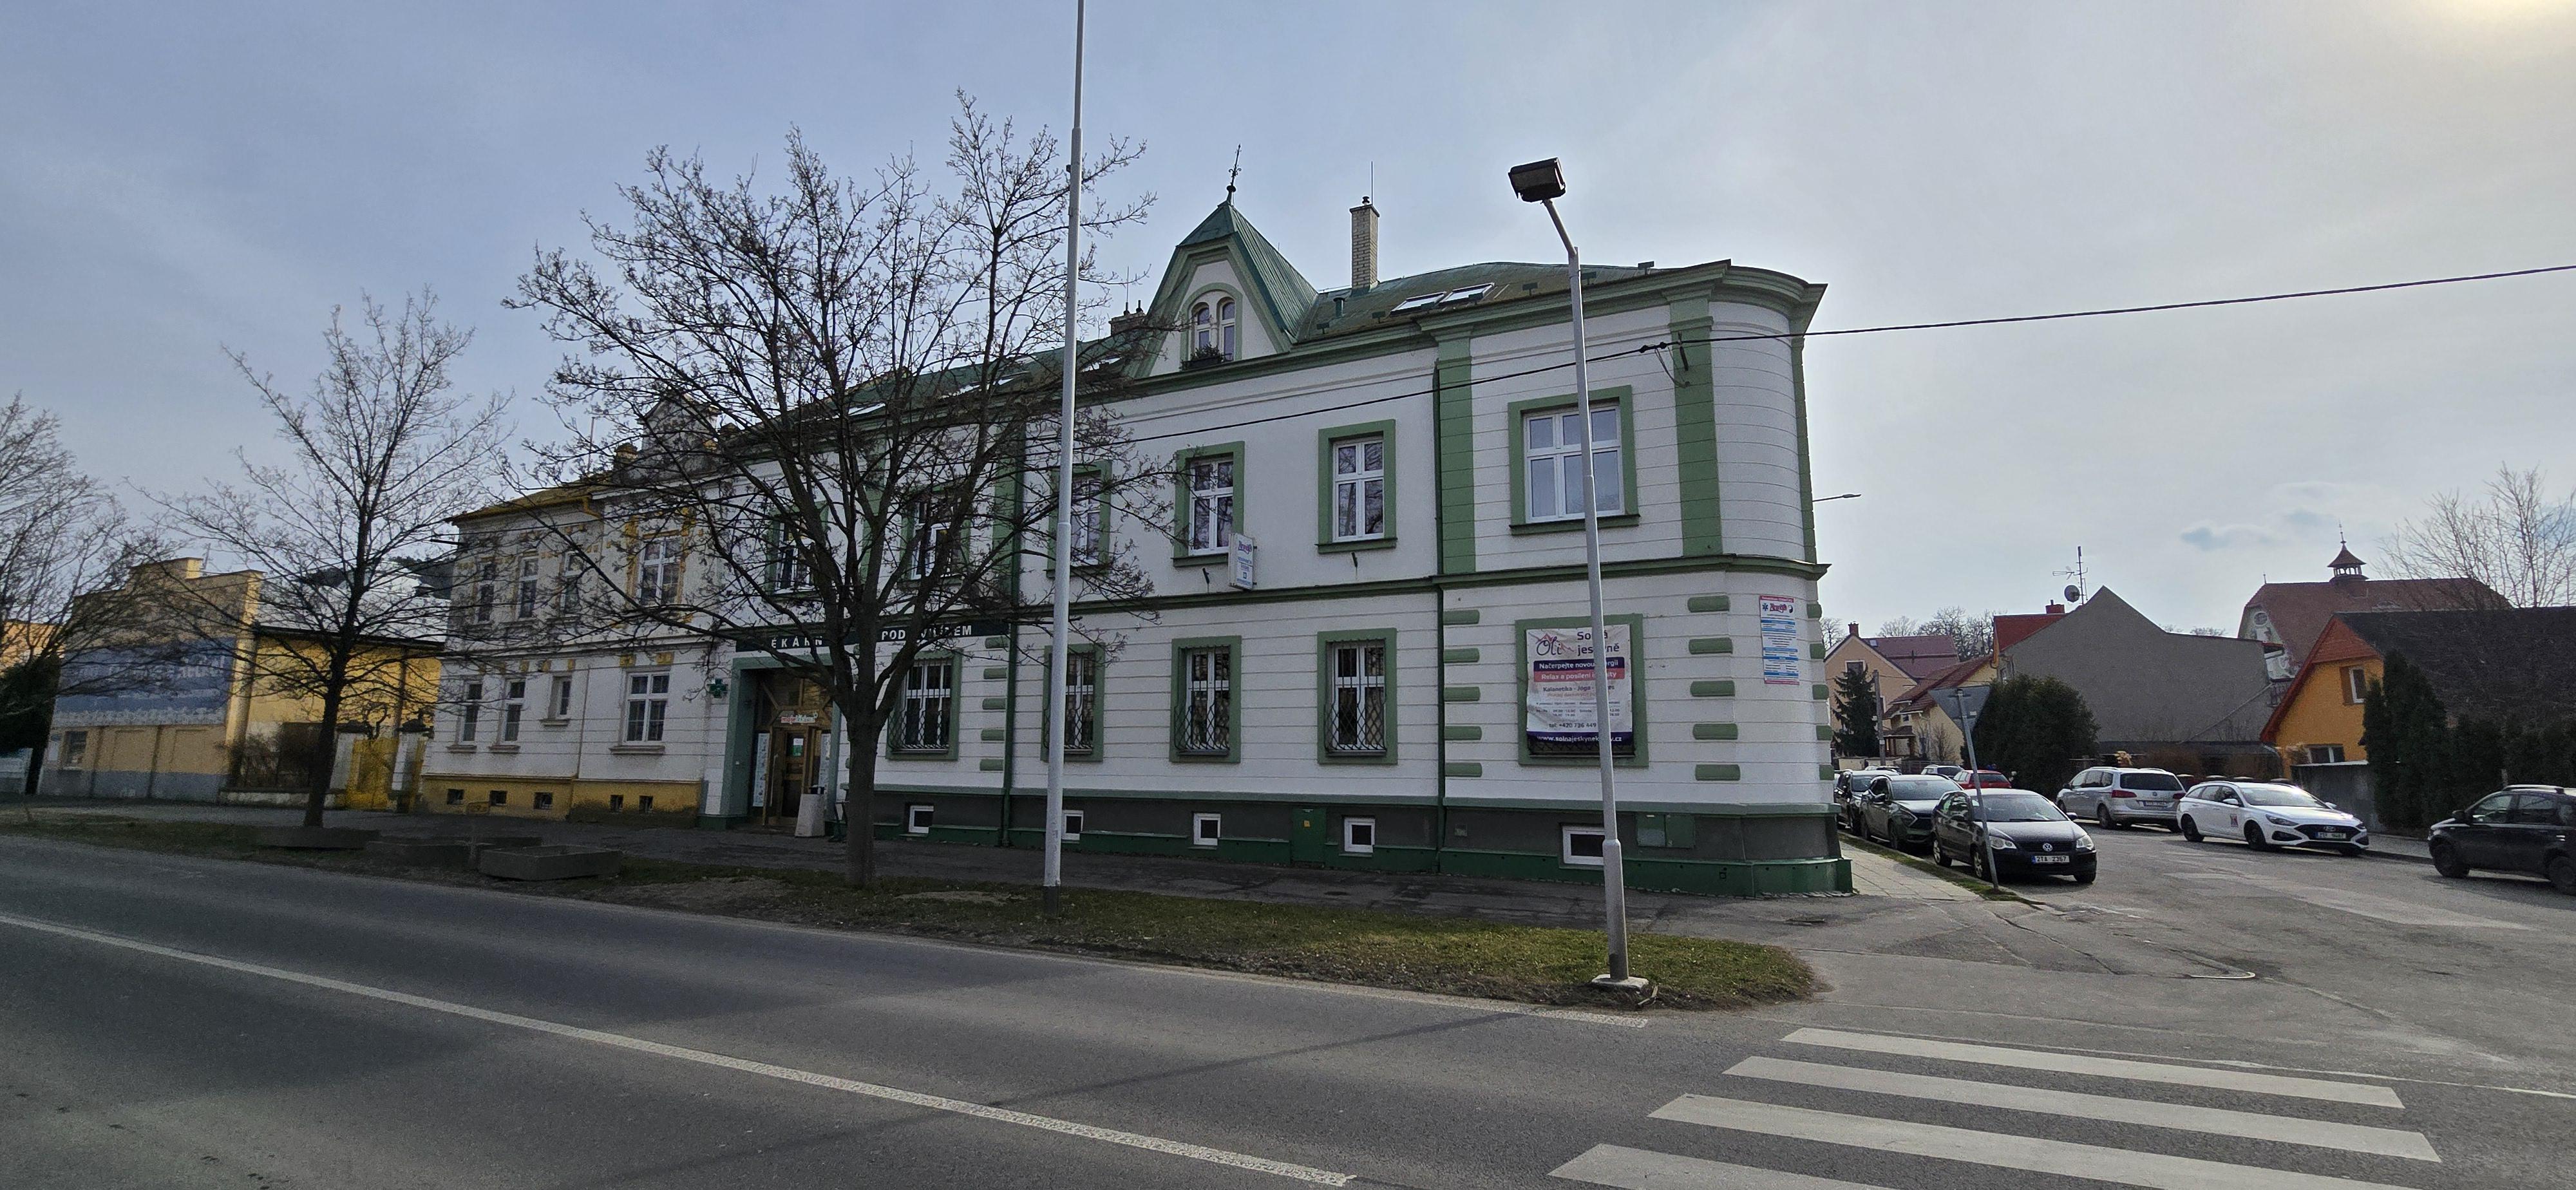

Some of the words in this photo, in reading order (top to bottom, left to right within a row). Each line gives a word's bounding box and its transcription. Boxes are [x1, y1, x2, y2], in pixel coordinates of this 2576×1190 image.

[881, 630, 906, 641] POD
[1577, 630, 1608, 641] Soá
[1577, 643, 1620, 656] jesně
[1539, 662, 1575, 670] Načerpejte
[1566, 672, 1591, 681] posílení
